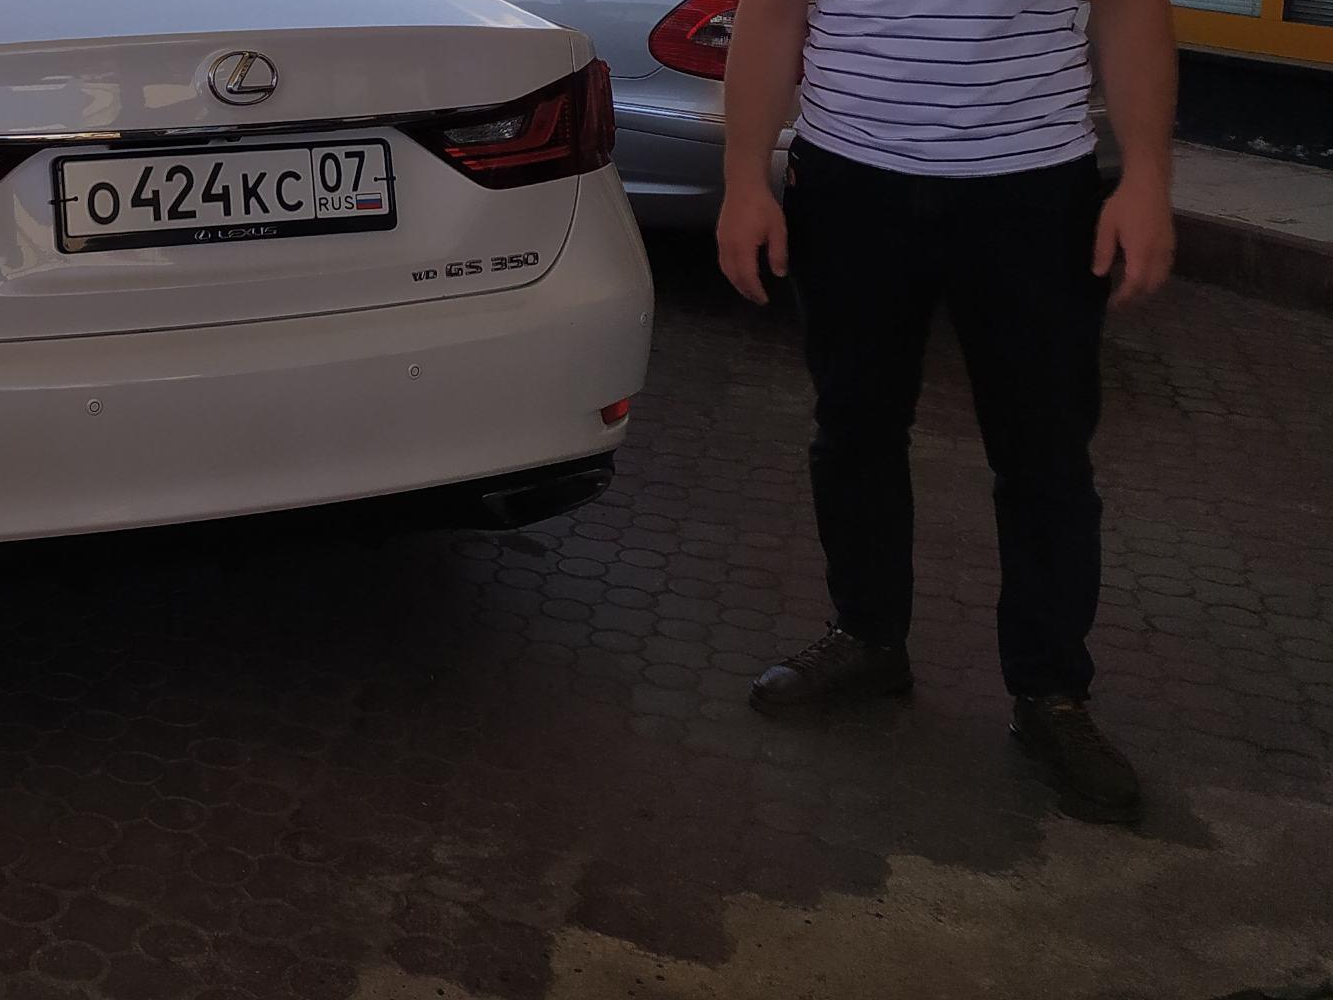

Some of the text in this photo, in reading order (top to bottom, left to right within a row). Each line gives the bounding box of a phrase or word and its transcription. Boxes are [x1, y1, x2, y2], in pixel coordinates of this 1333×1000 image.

[319, 150, 366, 194] 07
[318, 196, 355, 213] RUS
[218, 226, 278, 240] LEXUS
[445, 259, 483, 277] GS
[490, 252, 539, 272] 350
